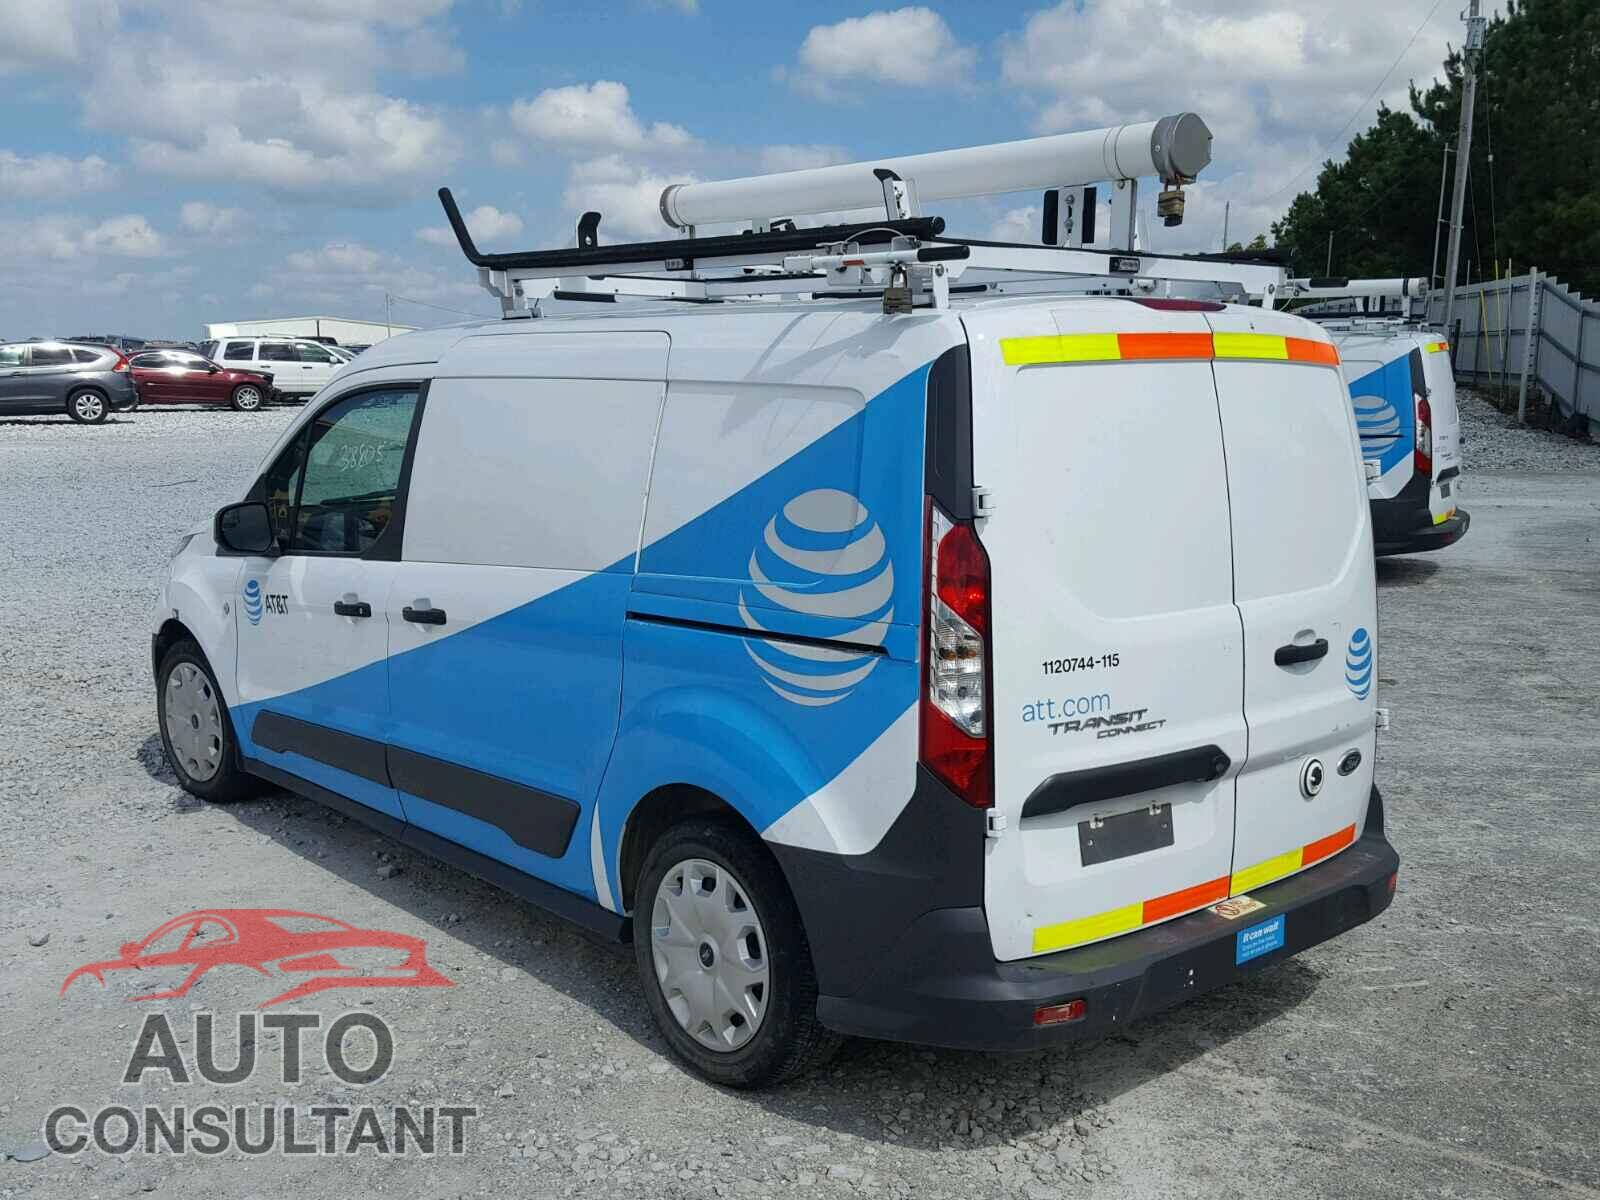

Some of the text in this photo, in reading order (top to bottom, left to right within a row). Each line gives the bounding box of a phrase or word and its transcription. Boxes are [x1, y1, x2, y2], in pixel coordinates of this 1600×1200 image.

[266, 594, 289, 615] AT&T
[1042, 653, 1120, 675] 1120744-115
[1022, 693, 1111, 722] att.com
[1048, 708, 1148, 735] TRANSIT
[1097, 719, 1167, 739] CONNECT
